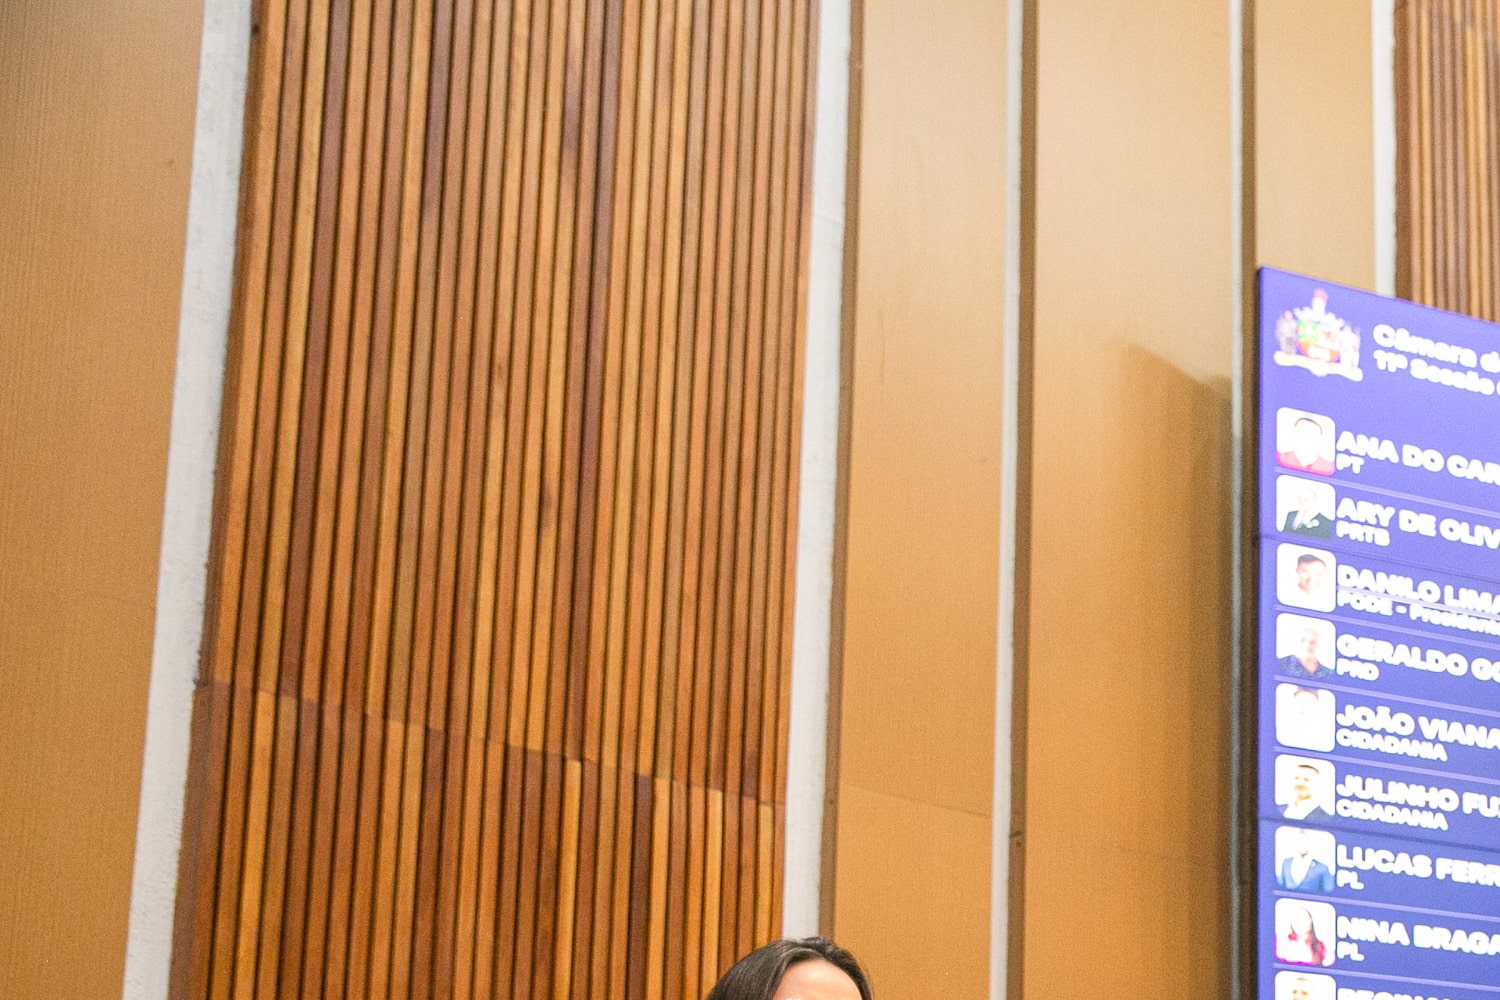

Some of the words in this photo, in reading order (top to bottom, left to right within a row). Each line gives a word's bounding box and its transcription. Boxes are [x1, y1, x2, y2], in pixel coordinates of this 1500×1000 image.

[1373, 324, 1477, 368] Câmara
[1336, 431, 1399, 463] ANA
[1402, 444, 1444, 472] DO
[1336, 453, 1365, 474] PT
[1336, 497, 1395, 527] ARY
[1399, 509, 1436, 537] DE
[1336, 520, 1390, 546] PRTB
[1337, 564, 1442, 605] DANILO
[1337, 592, 1393, 616] PODE
[1336, 634, 1468, 676] GERALDO
[1336, 704, 1415, 736] JOÃO
[1336, 728, 1448, 761] CIDADANIA
[1336, 774, 1459, 812] JULINHO
[1336, 799, 1448, 830] CIDADANIA
[1337, 844, 1432, 878] LUCAS
[1337, 869, 1364, 890] PL
[1337, 916, 1410, 946] NINA
[1337, 941, 1364, 961] PL
